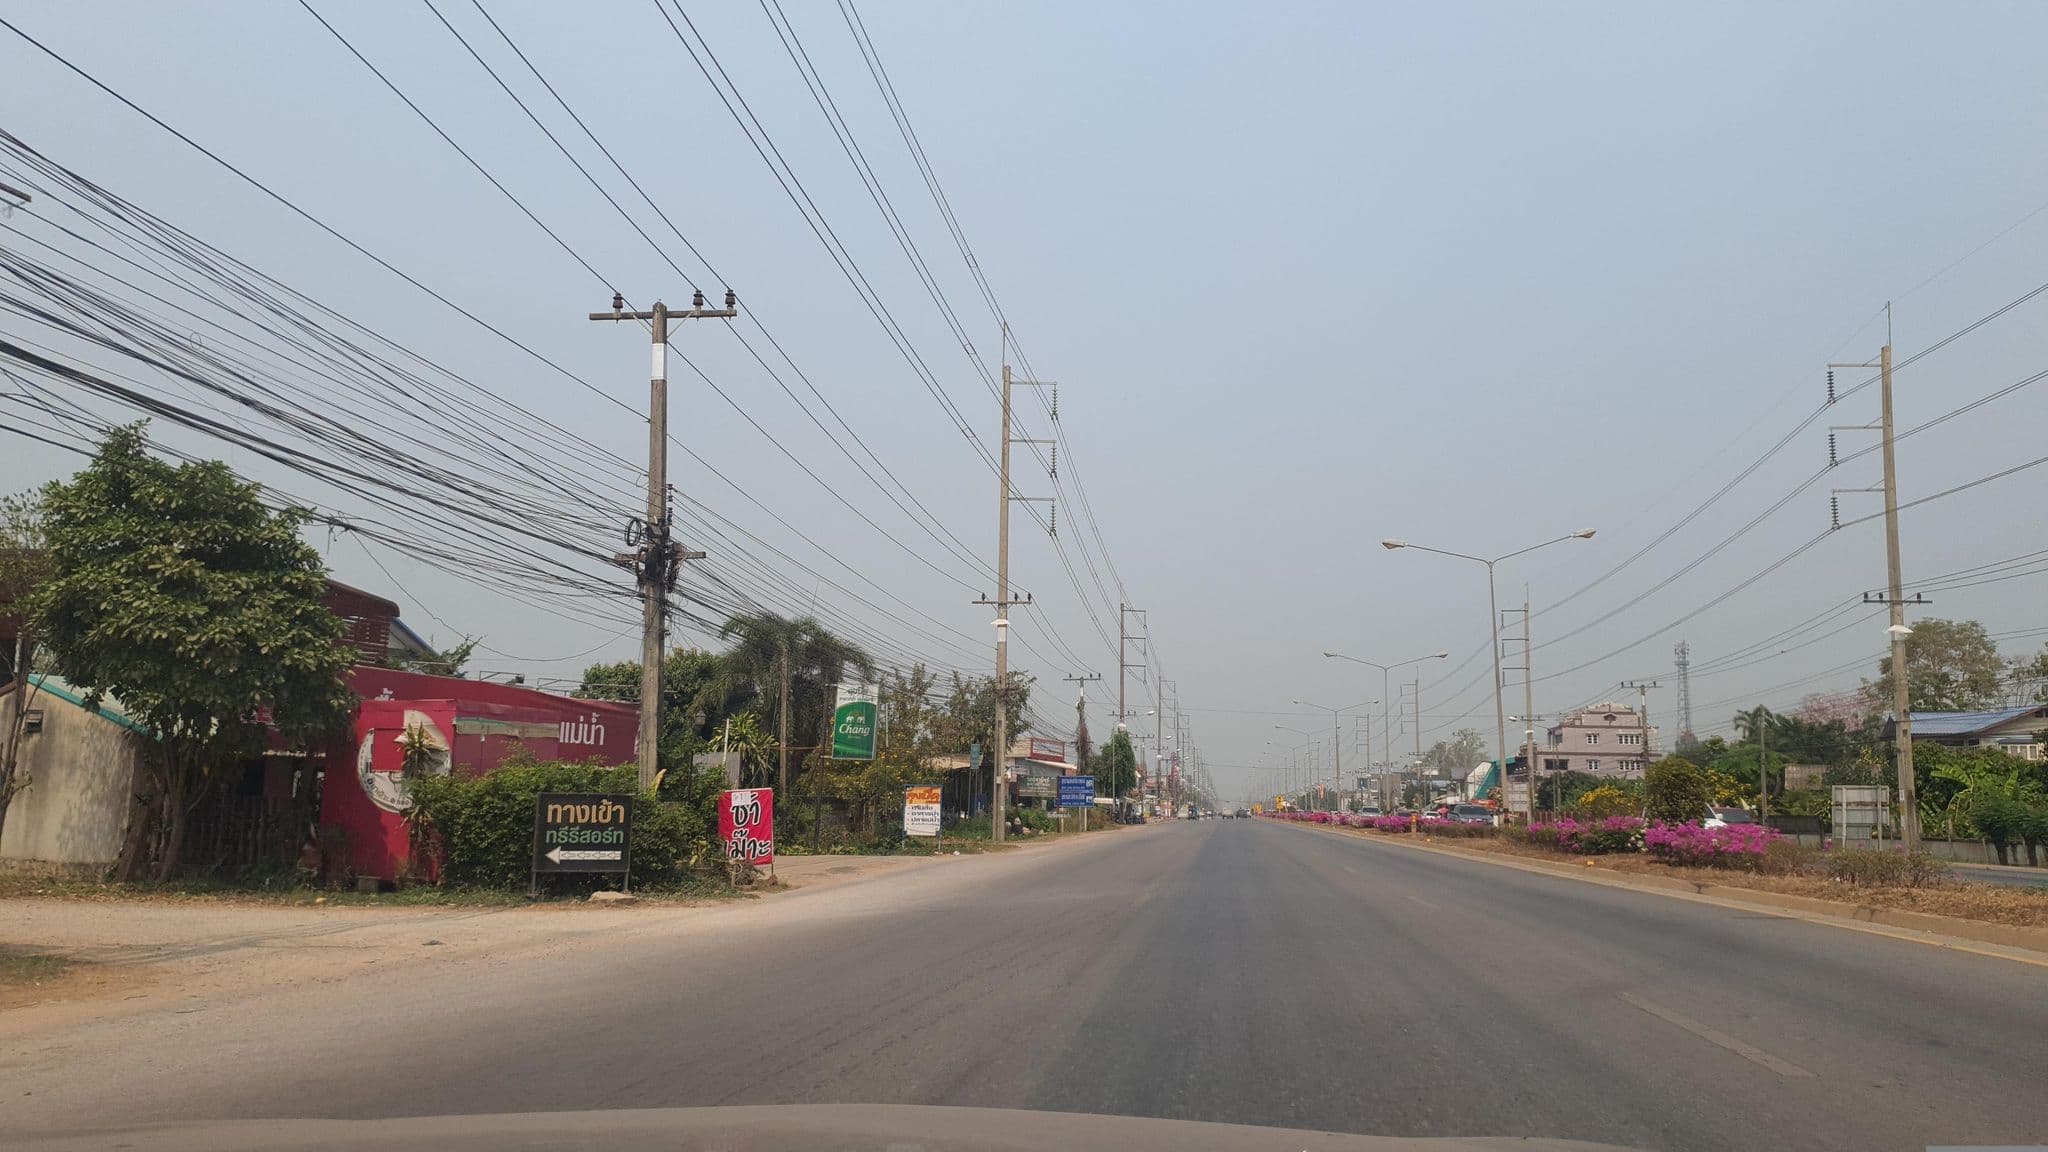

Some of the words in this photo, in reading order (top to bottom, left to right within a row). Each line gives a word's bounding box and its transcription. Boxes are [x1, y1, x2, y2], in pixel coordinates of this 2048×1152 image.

[559, 712, 605, 745] แม่น้ำ
[839, 723, 871, 736] Chang
[546, 799, 625, 824] ทางเข้า
[545, 826, 624, 844] ทรีรีสอร์ท
